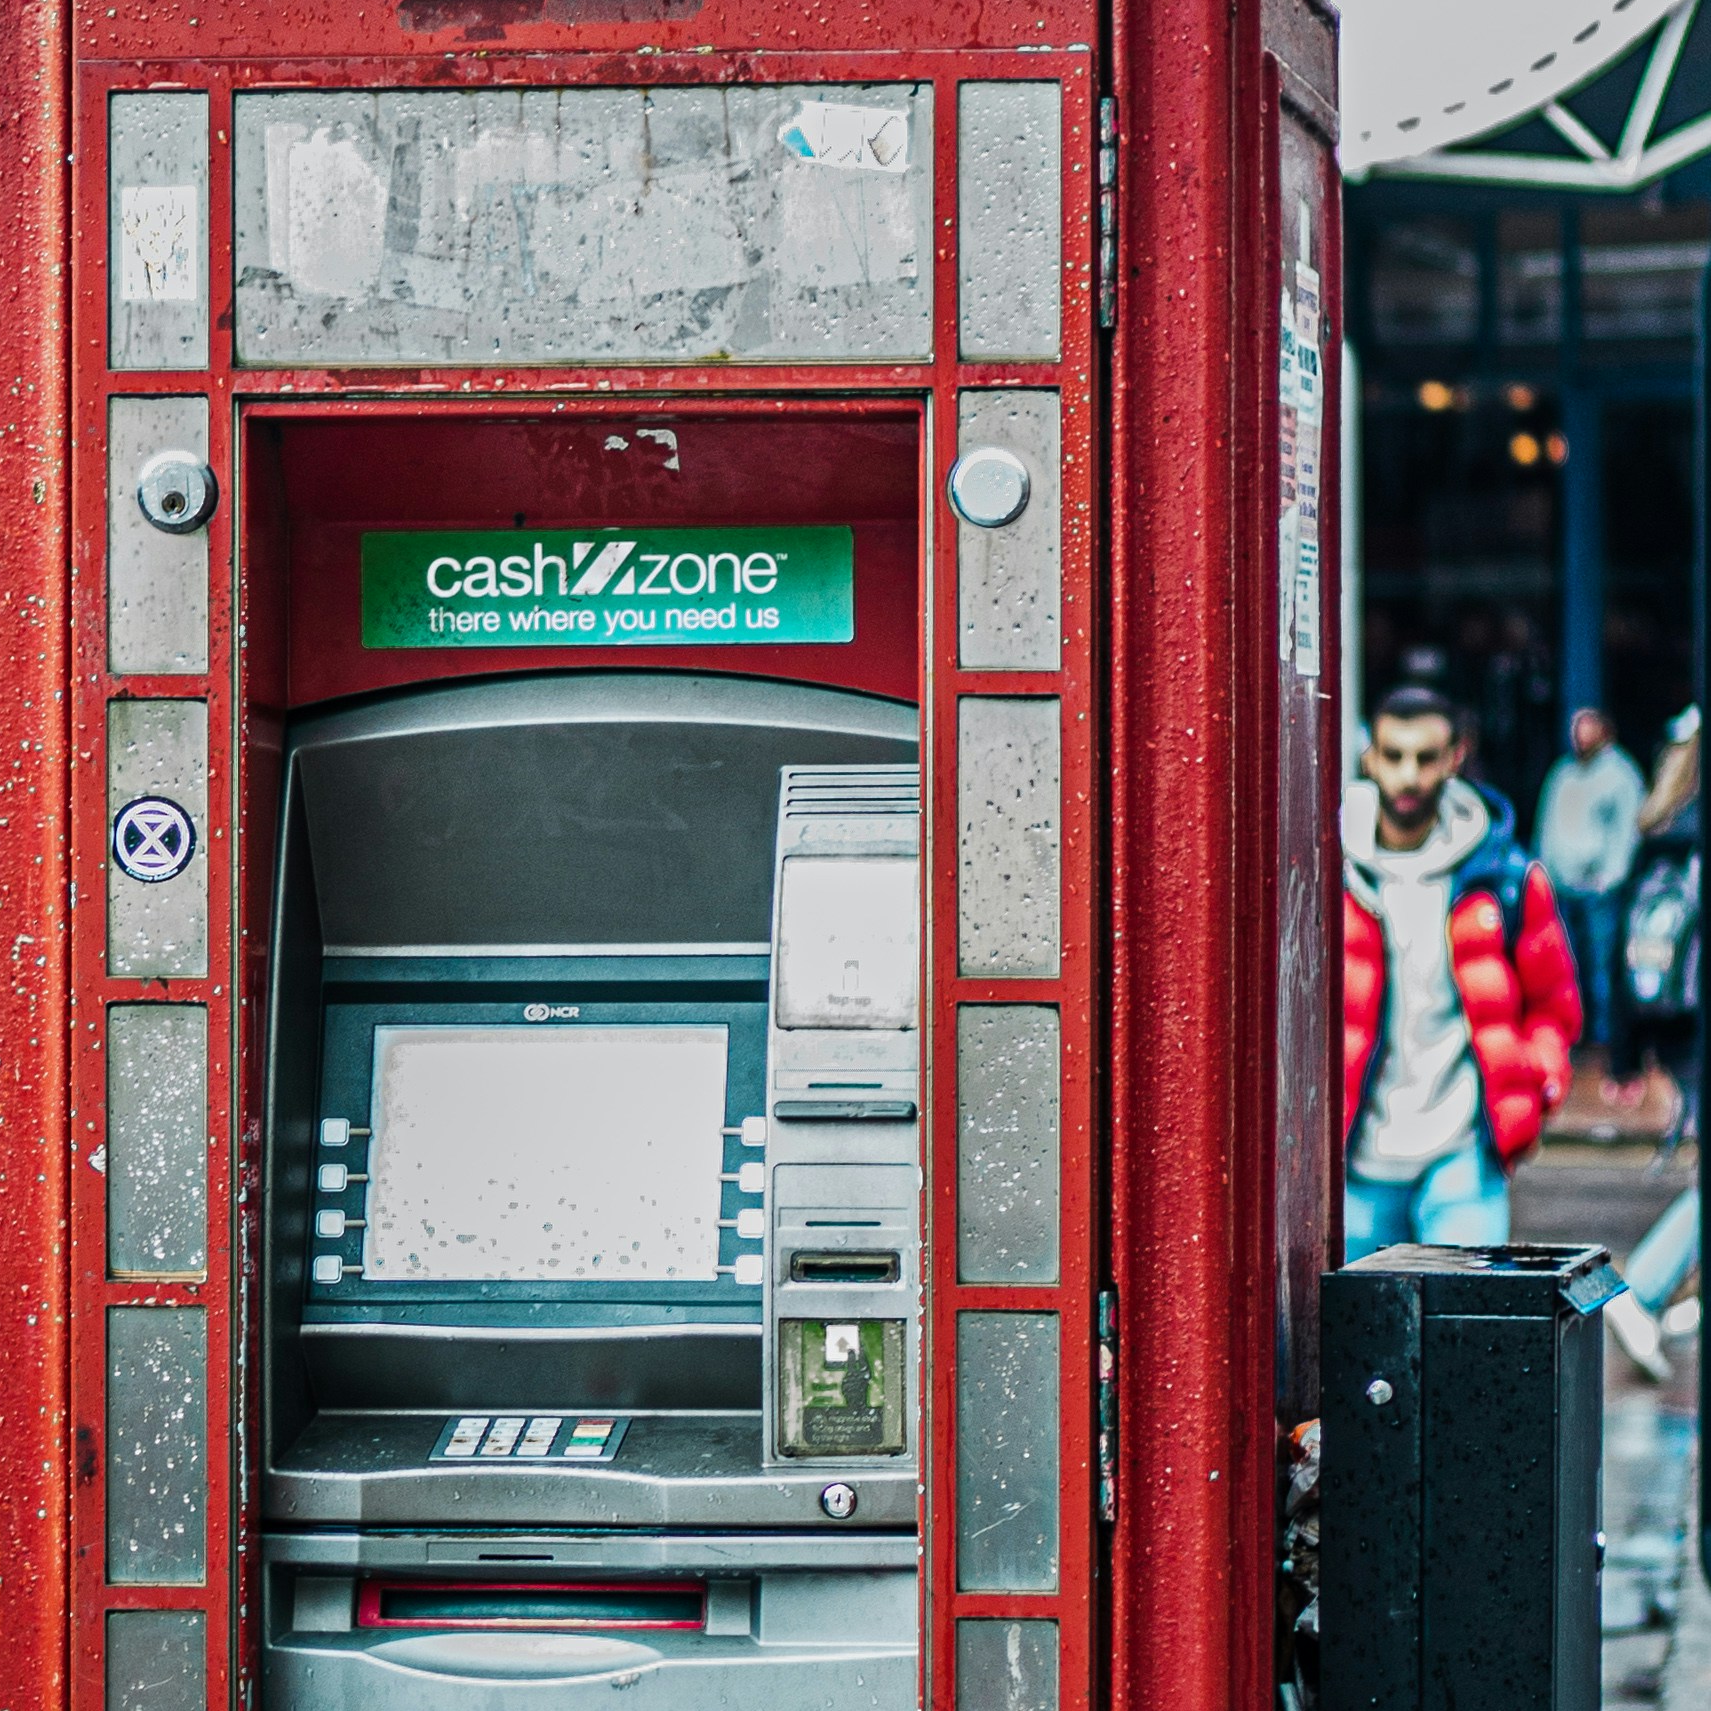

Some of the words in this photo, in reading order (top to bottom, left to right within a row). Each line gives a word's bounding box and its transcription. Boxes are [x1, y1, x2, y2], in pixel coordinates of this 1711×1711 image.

[426, 542, 568, 598] cash
[637, 552, 778, 595] zone
[428, 606, 501, 633] there
[508, 604, 596, 632] where
[603, 608, 656, 636] you
[664, 602, 736, 629] need
[745, 607, 780, 629] us
[550, 1006, 580, 1018] NCR
